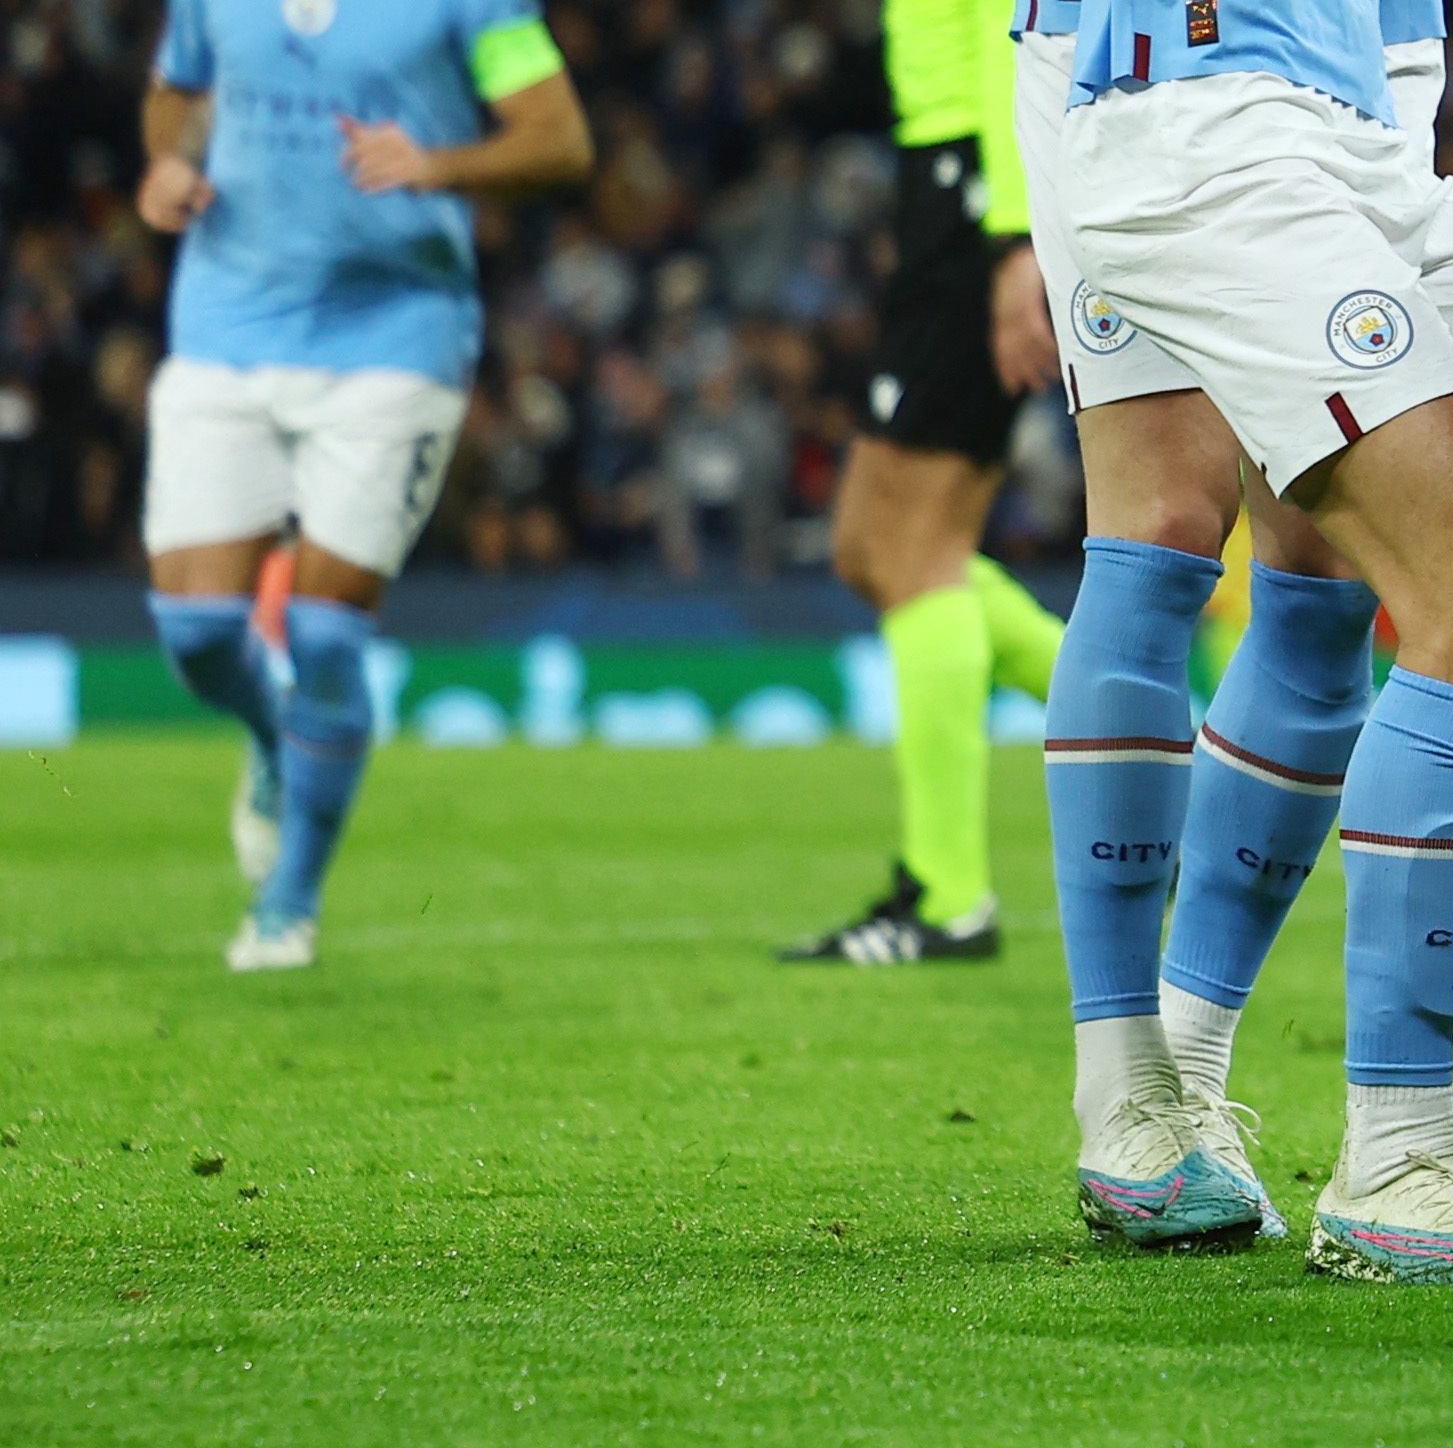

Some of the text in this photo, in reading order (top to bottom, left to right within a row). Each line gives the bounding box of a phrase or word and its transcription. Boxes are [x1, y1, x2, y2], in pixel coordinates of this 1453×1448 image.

[1333, 296, 1394, 337] MANCHESTER
[1098, 338, 1120, 350] CITY
[1375, 347, 1399, 364] CITY
